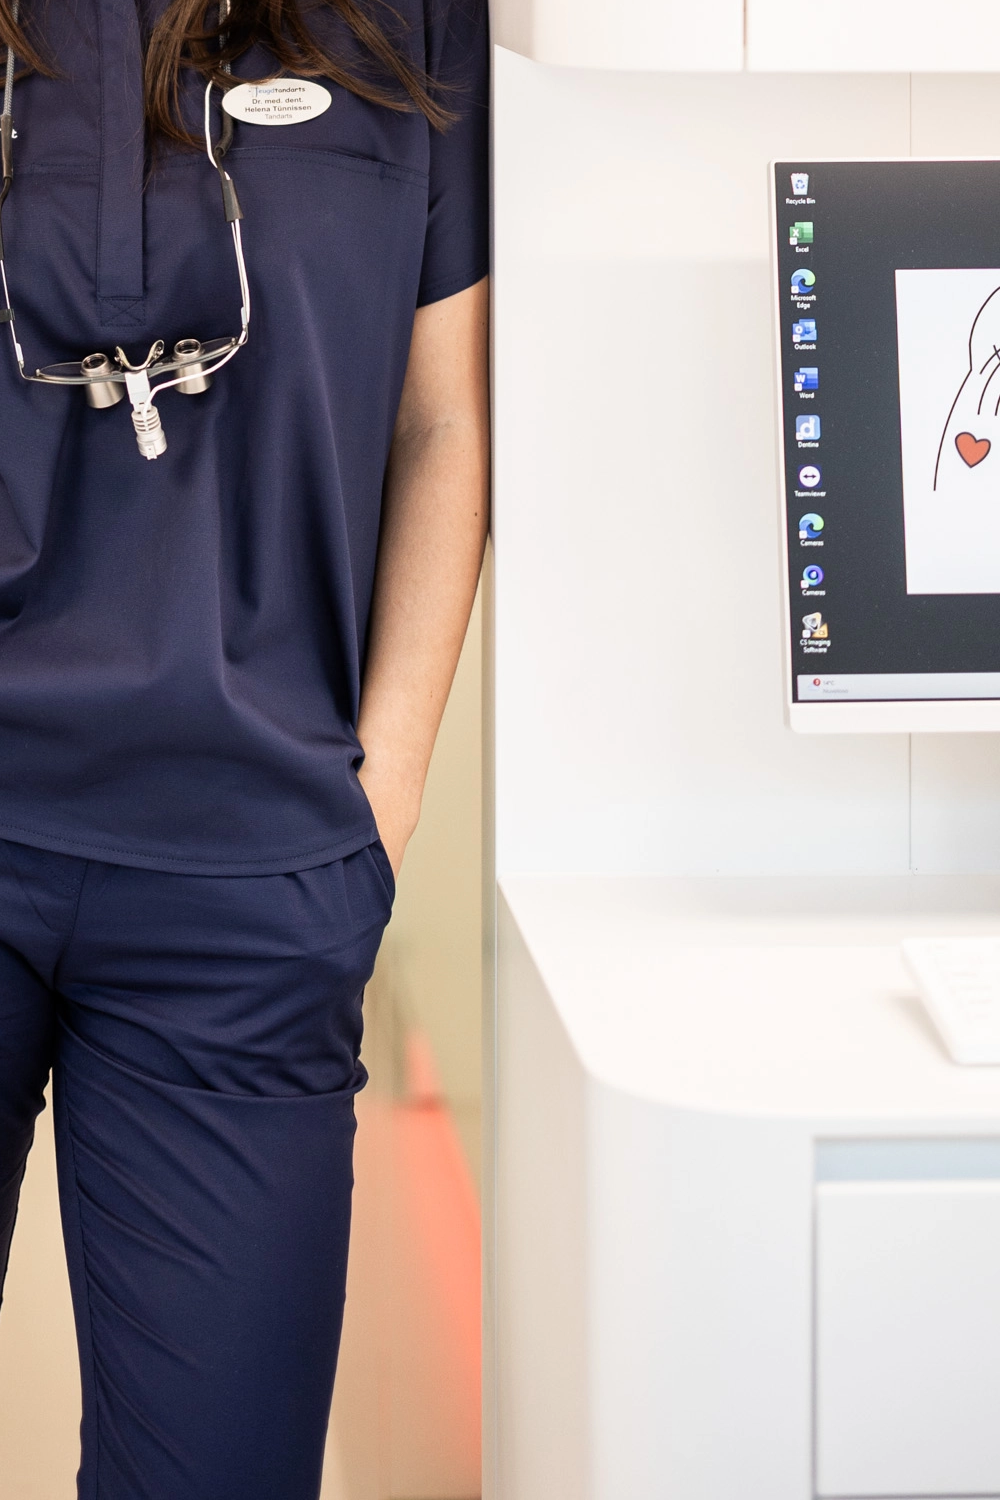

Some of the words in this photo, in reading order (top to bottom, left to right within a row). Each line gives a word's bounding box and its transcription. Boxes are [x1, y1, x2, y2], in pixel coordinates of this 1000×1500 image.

[785, 198, 806, 206] Recycle
[796, 302, 811, 310] Edge
[808, 639, 832, 647] Imaging
